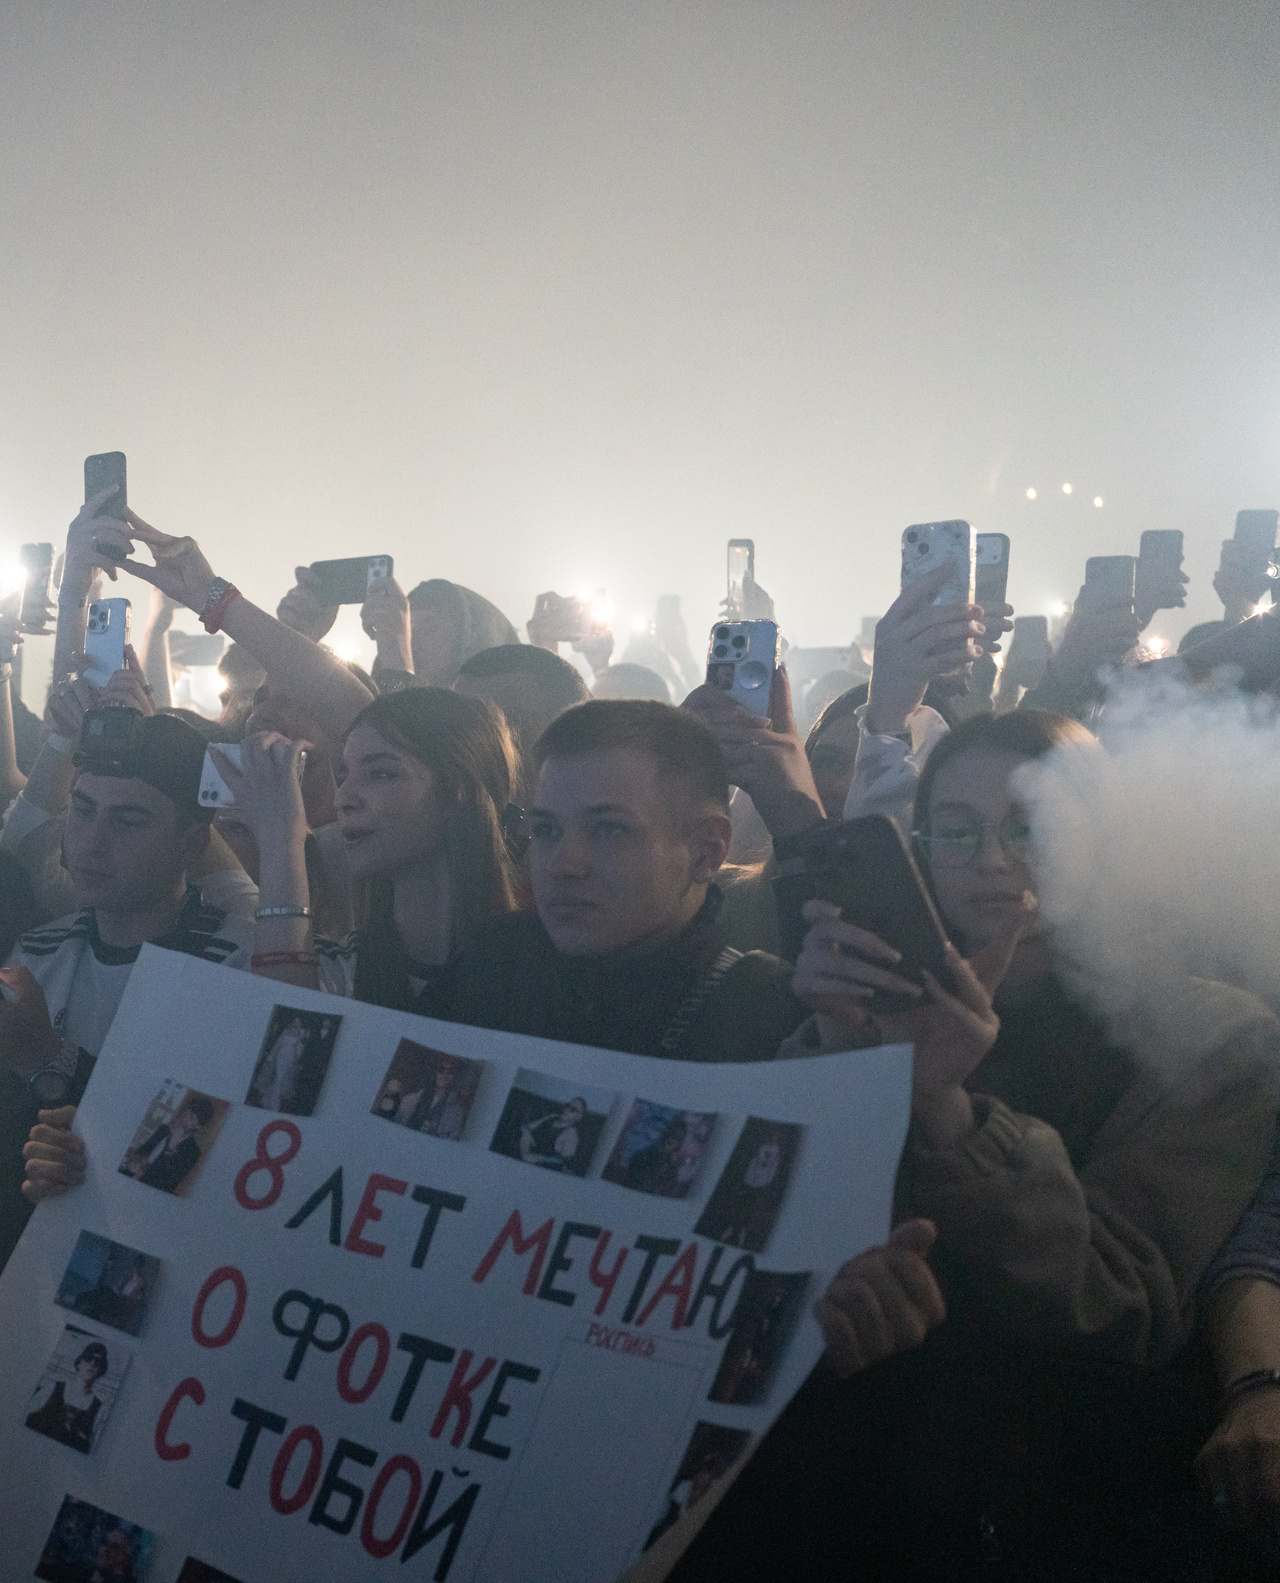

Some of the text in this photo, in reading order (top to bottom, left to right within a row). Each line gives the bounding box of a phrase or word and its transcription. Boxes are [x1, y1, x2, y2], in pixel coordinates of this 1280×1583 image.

[234, 1119, 756, 1338] 8 ЛЕТ МЕЧТАЮ
[190, 1265, 542, 1461] О ФОТКЕ
[154, 1376, 483, 1583] С ТОБОЙ
